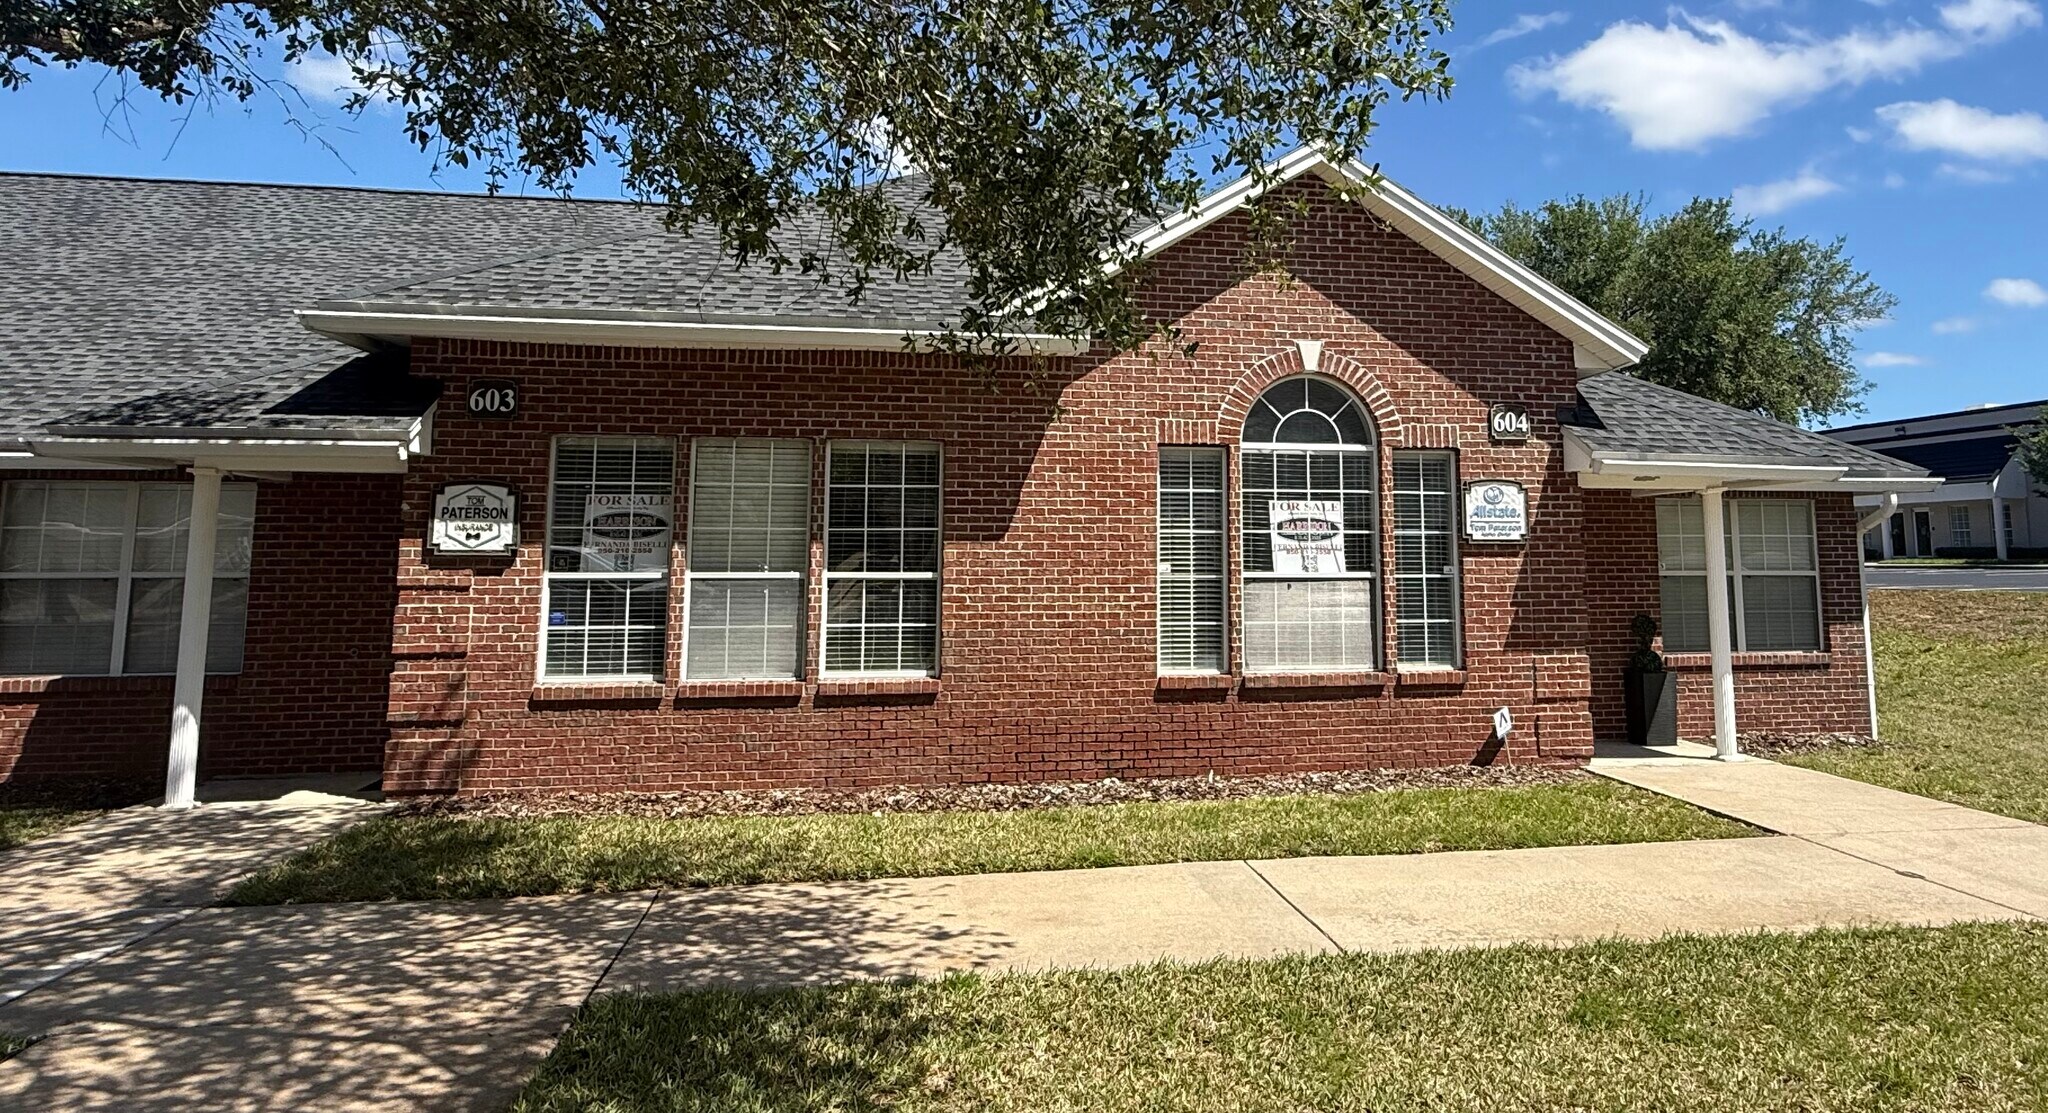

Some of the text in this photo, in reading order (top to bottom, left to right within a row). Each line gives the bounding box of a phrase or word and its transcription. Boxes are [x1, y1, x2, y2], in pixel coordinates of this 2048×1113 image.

[469, 388, 515, 412] 603
[1493, 411, 1528, 432] 604
[467, 497, 485, 505] TOM
[588, 495, 671, 506] FOR SALE
[1272, 502, 1339, 511] FOR SALE
[441, 506, 508, 519] PATERSON
[1470, 524, 1486, 532] Tom
